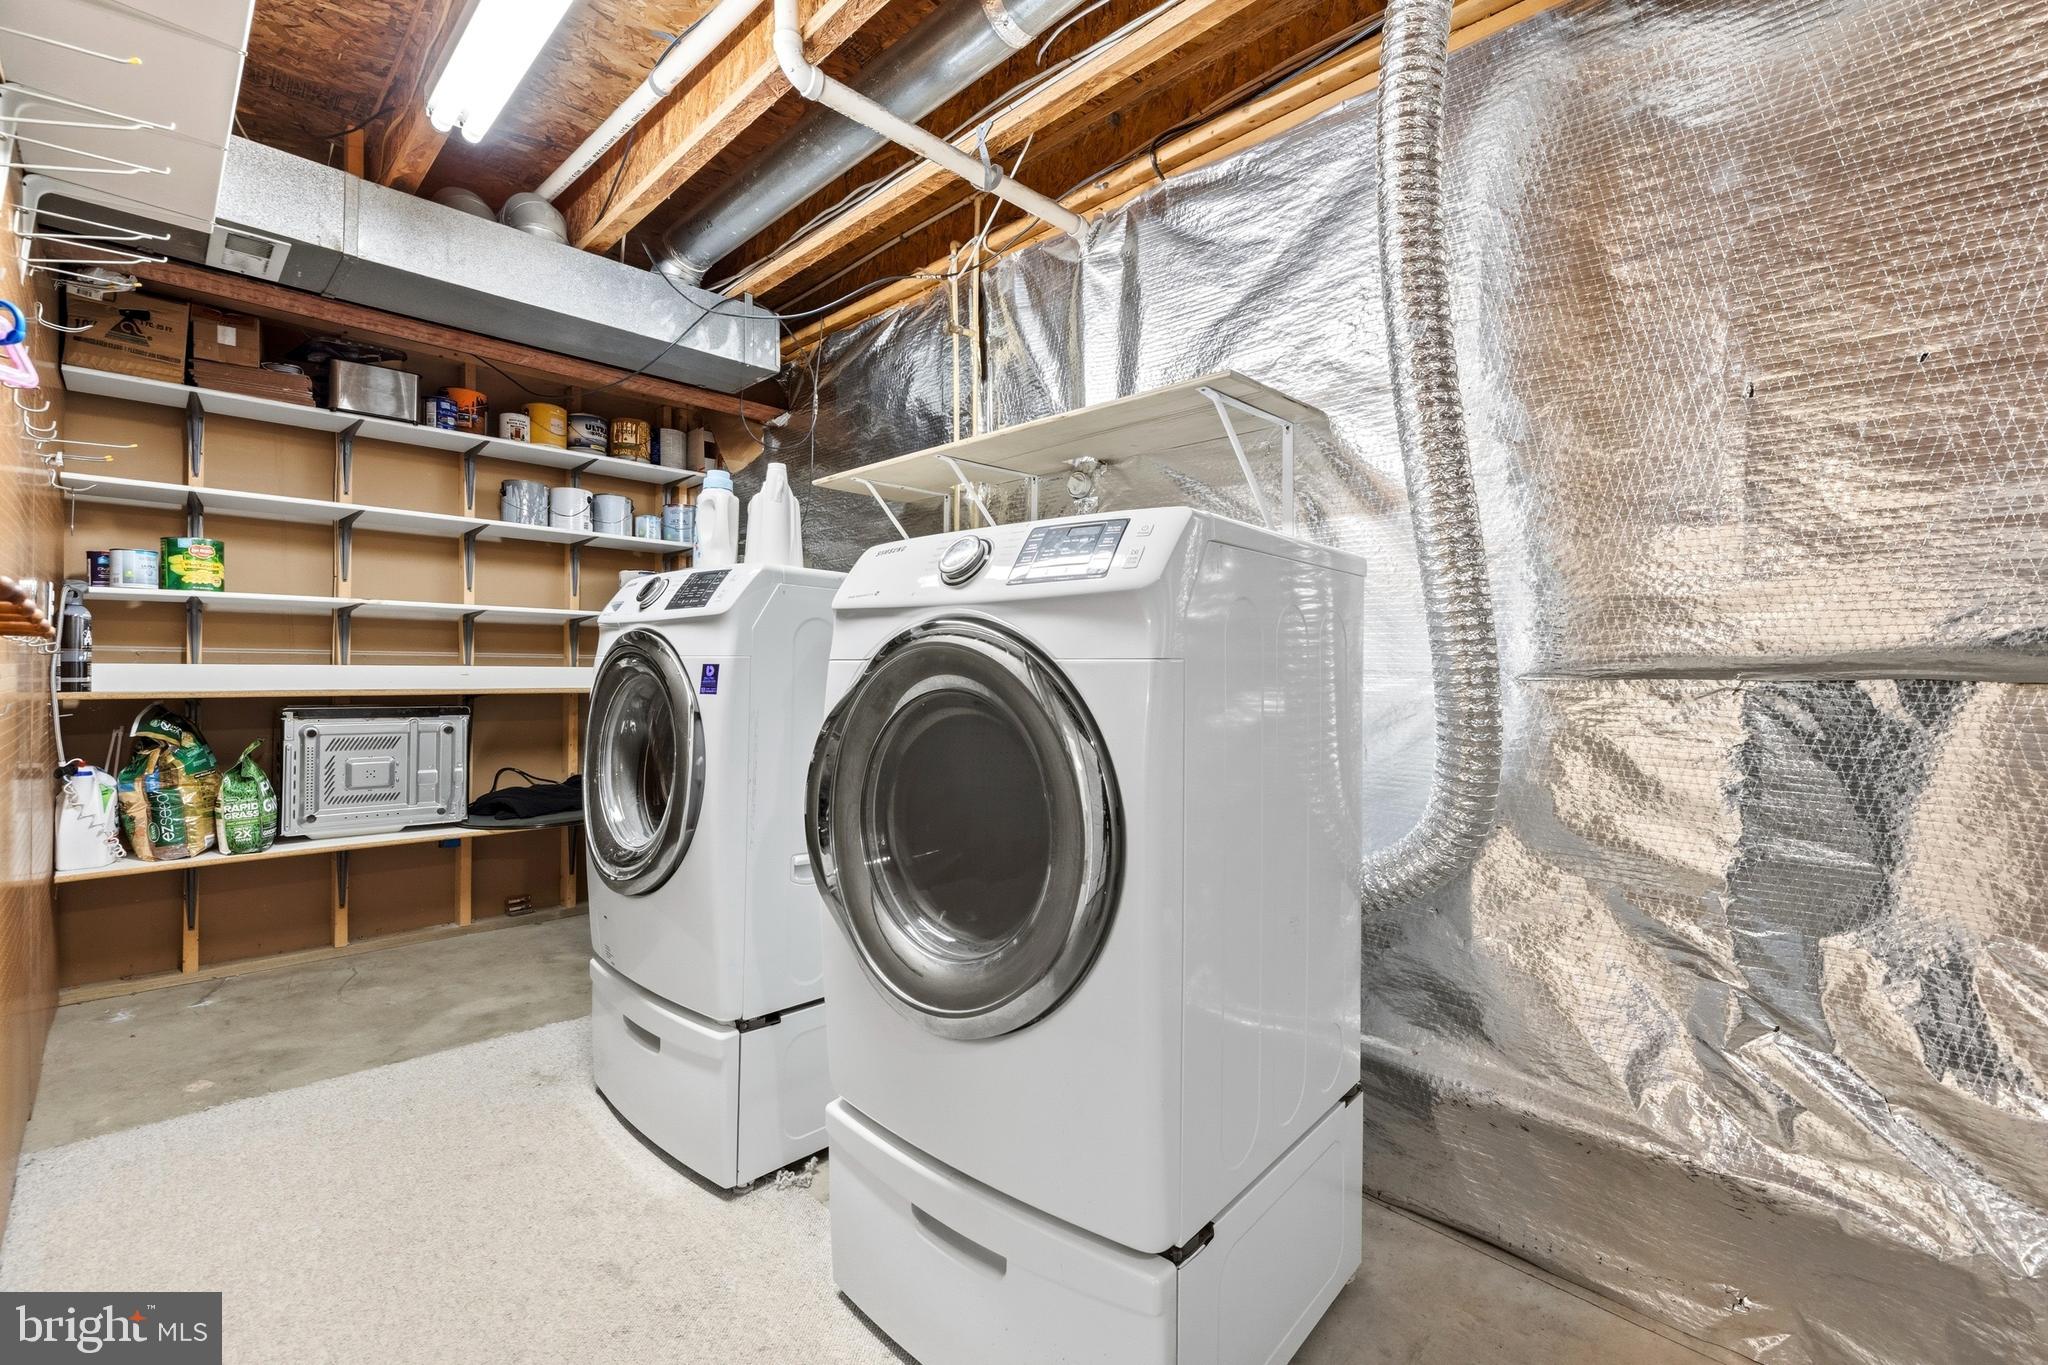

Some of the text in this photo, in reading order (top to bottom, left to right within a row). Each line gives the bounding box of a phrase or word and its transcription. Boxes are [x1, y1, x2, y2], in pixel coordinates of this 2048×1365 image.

[593, 135, 617, 158] PRESSURE
[619, 123, 630, 134] USE
[631, 108, 646, 122] ONLY
[224, 802, 259, 813] RAPID
[224, 810, 260, 820] GRASS
[234, 828, 252, 839] 2X
